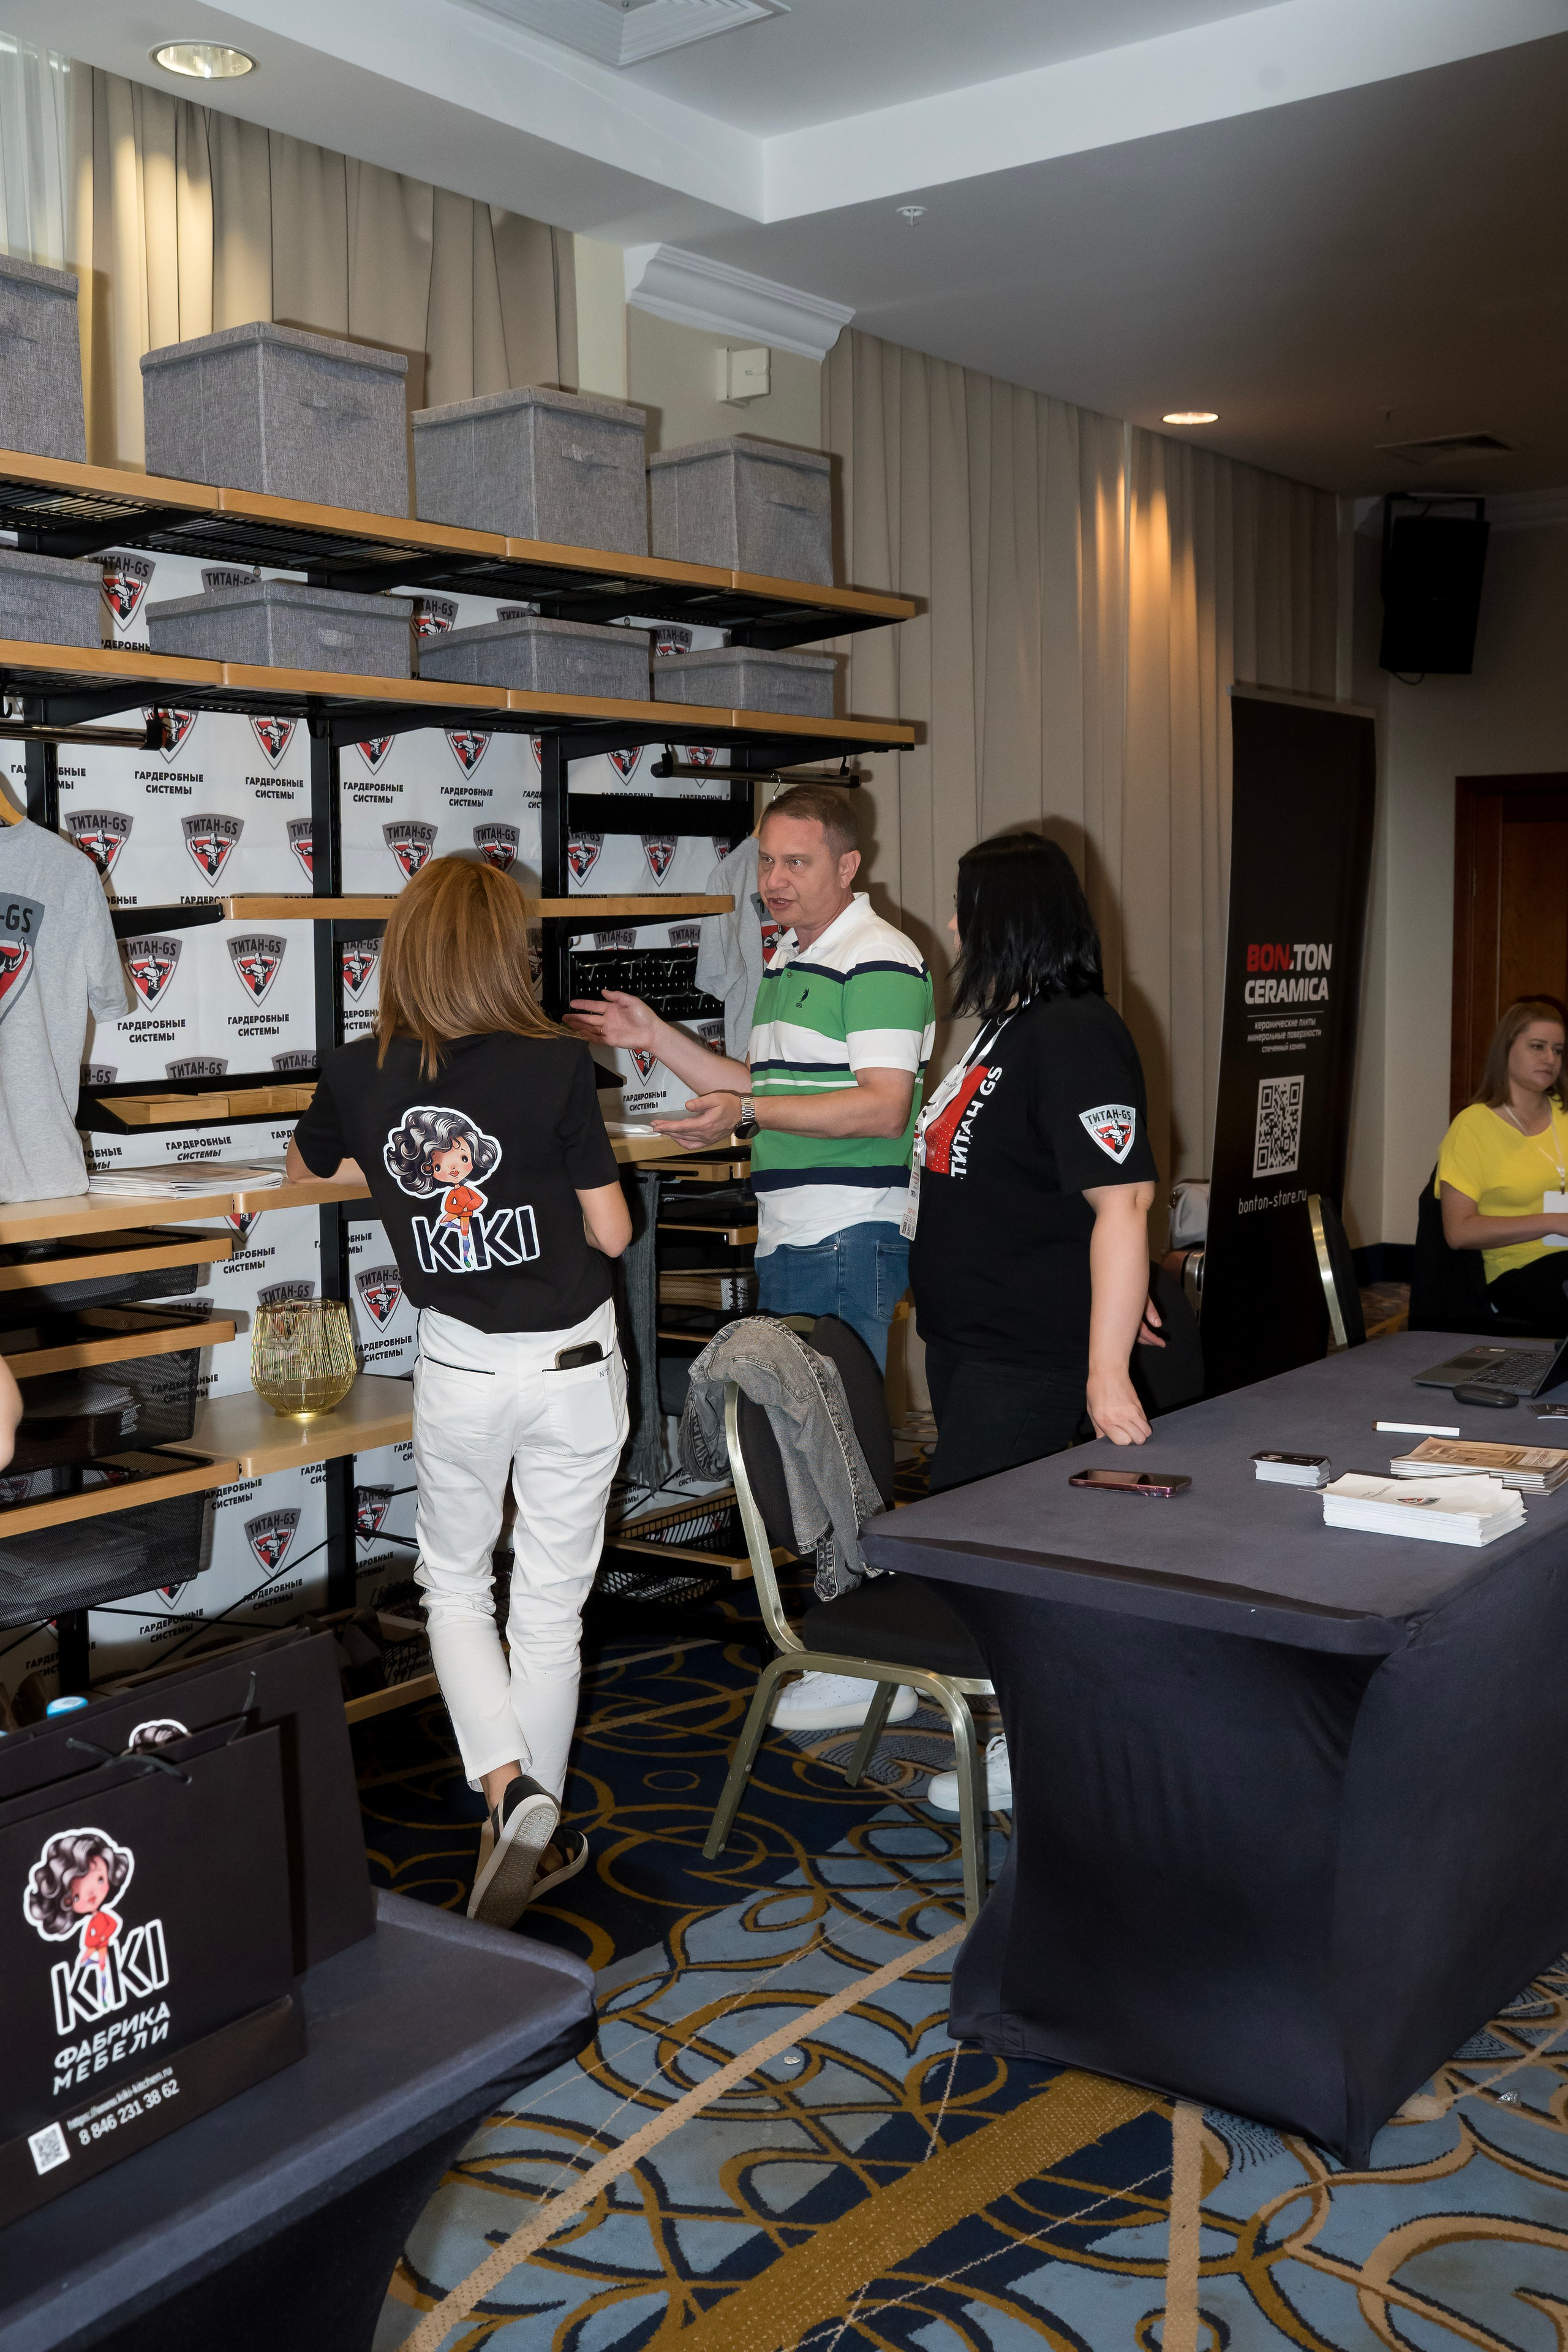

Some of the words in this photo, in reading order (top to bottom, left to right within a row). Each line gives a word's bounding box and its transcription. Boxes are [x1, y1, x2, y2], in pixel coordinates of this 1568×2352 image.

[205, 572, 257, 586] ТИТАН-G
[134, 771, 204, 783] ГАРДЕРОБНЫЕ
[246, 777, 304, 788] ГАРДЕРОБНЫЕ
[145, 785, 192, 795] СИСТЕМЫ
[344, 782, 404, 792] ГАРДЕРОБНЫЕ
[440, 786, 493, 796] ГАРДЕРОБНЫЕ
[255, 790, 294, 799] СИСТЕМЫ
[353, 794, 393, 804] СИСТЕМЫ
[449, 799, 483, 807] СИСТЕМЫ
[69, 815, 127, 832] ТИТАН-GS
[186, 818, 238, 835] ТИТАН-GS
[386, 826, 432, 840] ТИТАН-GS
[476, 827, 516, 842] ТИТАН-GS
[123, 940, 176, 956] ТИТАН-GS
[232, 939, 281, 954] ТИТАН-GS
[1245, 977, 1329, 1004] CERAMICA
[118, 1019, 186, 1031] ГАРДЕРОБНЫЕ
[228, 1014, 289, 1025] ГАРДЕРОБНЫЕ
[1255, 1019, 1298, 1031] керамические
[129, 1033, 175, 1042] СИСТЕМЫ
[238, 1027, 279, 1036] СИСТЕМЫ
[1247, 1031, 1286, 1042] минеральные
[1287, 1029, 1322, 1039] поверхности
[170, 1061, 222, 1079] ТИТАН-GS
[276, 1055, 317, 1071] ТИТАН-G
[623, 1090, 666, 1102] ГАРДЕРОБНЫЕ
[629, 1101, 658, 1111] СИСТЕМЫ
[951, 1101, 984, 1177] ТИТАН
[980, 1066, 1003, 1096] GS
[1085, 1109, 1131, 1125] ТИТАН-GS
[166, 1136, 232, 1150] ГАРДЕРОБНЫЕ
[177, 1149, 221, 1161] СИСТЕМЫ
[1238, 1189, 1307, 1214] bonton-store.ru
[223, 1261, 265, 1274] СИСТЕМЫ
[355, 1335, 412, 1352] ГАРДЕРОБНЫЕ
[364, 1349, 403, 1362] СИСТЕМЫ
[205, 1479, 262, 1499] АРДЕРОБНЫЕ
[211, 1493, 253, 1510] СИСТЕМЫ
[608, 1494, 639, 1509] СИСТЕМЫ
[248, 1512, 296, 1536] ТИТАН-GS
[253, 1593, 293, 1611] СИСТЕМЫ
[140, 1608, 203, 1635] ГАРДЕРОНЫЕ
[150, 1624, 193, 1643] СИСТЕМЫ
[54, 2001, 170, 2069] ФАБРИКА
[53, 2021, 169, 2095] МЕБЕЛИ
[78, 2128, 91, 2145] 8
[91, 2114, 118, 2139] 846
[118, 2099, 144, 2124] 231
[143, 2089, 162, 2108] 38
[161, 2079, 180, 2098] 62
